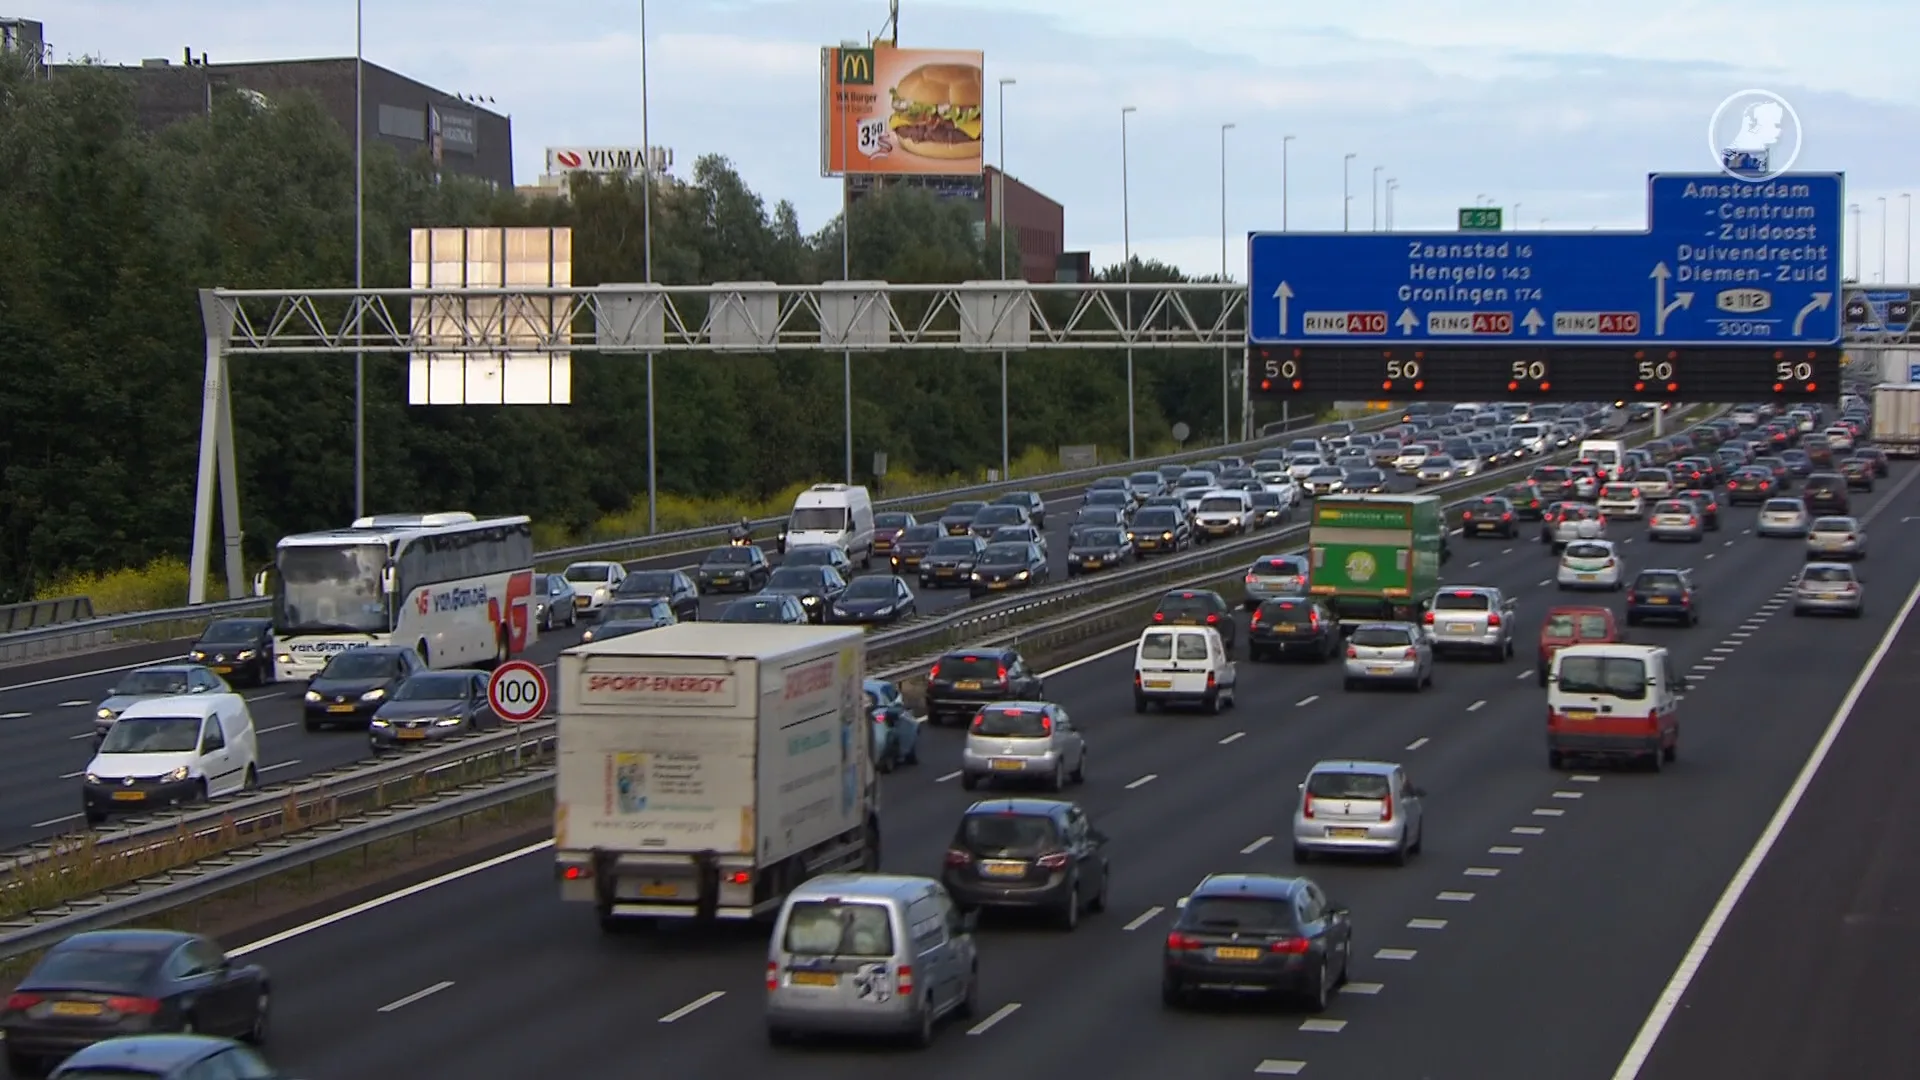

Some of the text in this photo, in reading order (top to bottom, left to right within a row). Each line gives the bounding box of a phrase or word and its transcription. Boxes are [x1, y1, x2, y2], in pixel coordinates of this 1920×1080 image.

[588, 150, 646, 168] VISMA
[1682, 182, 1809, 199] Amsterdam
[1408, 242, 1532, 259] Zaanstad 16
[1678, 245, 1827, 262] Duivendrecht
[1410, 264, 1531, 283] Hengelo 143
[1678, 265, 1827, 282] Diemen-Zuid
[1399, 285, 1541, 304] Groningen 174
[1737, 292, 1763, 308] 112
[1306, 316, 1385, 330] RING A10
[1430, 316, 1509, 330] RING A10
[1556, 315, 1637, 331] RING A10
[1717, 322, 1770, 336] 300m
[1265, 360, 1296, 378] 50
[1387, 361, 1419, 379] 50
[1512, 361, 1544, 379] 50
[1639, 362, 1672, 380] 50
[1777, 362, 1811, 380] 50
[499, 681, 537, 703] 100
[589, 676, 727, 692] SPORT-ENERGY
